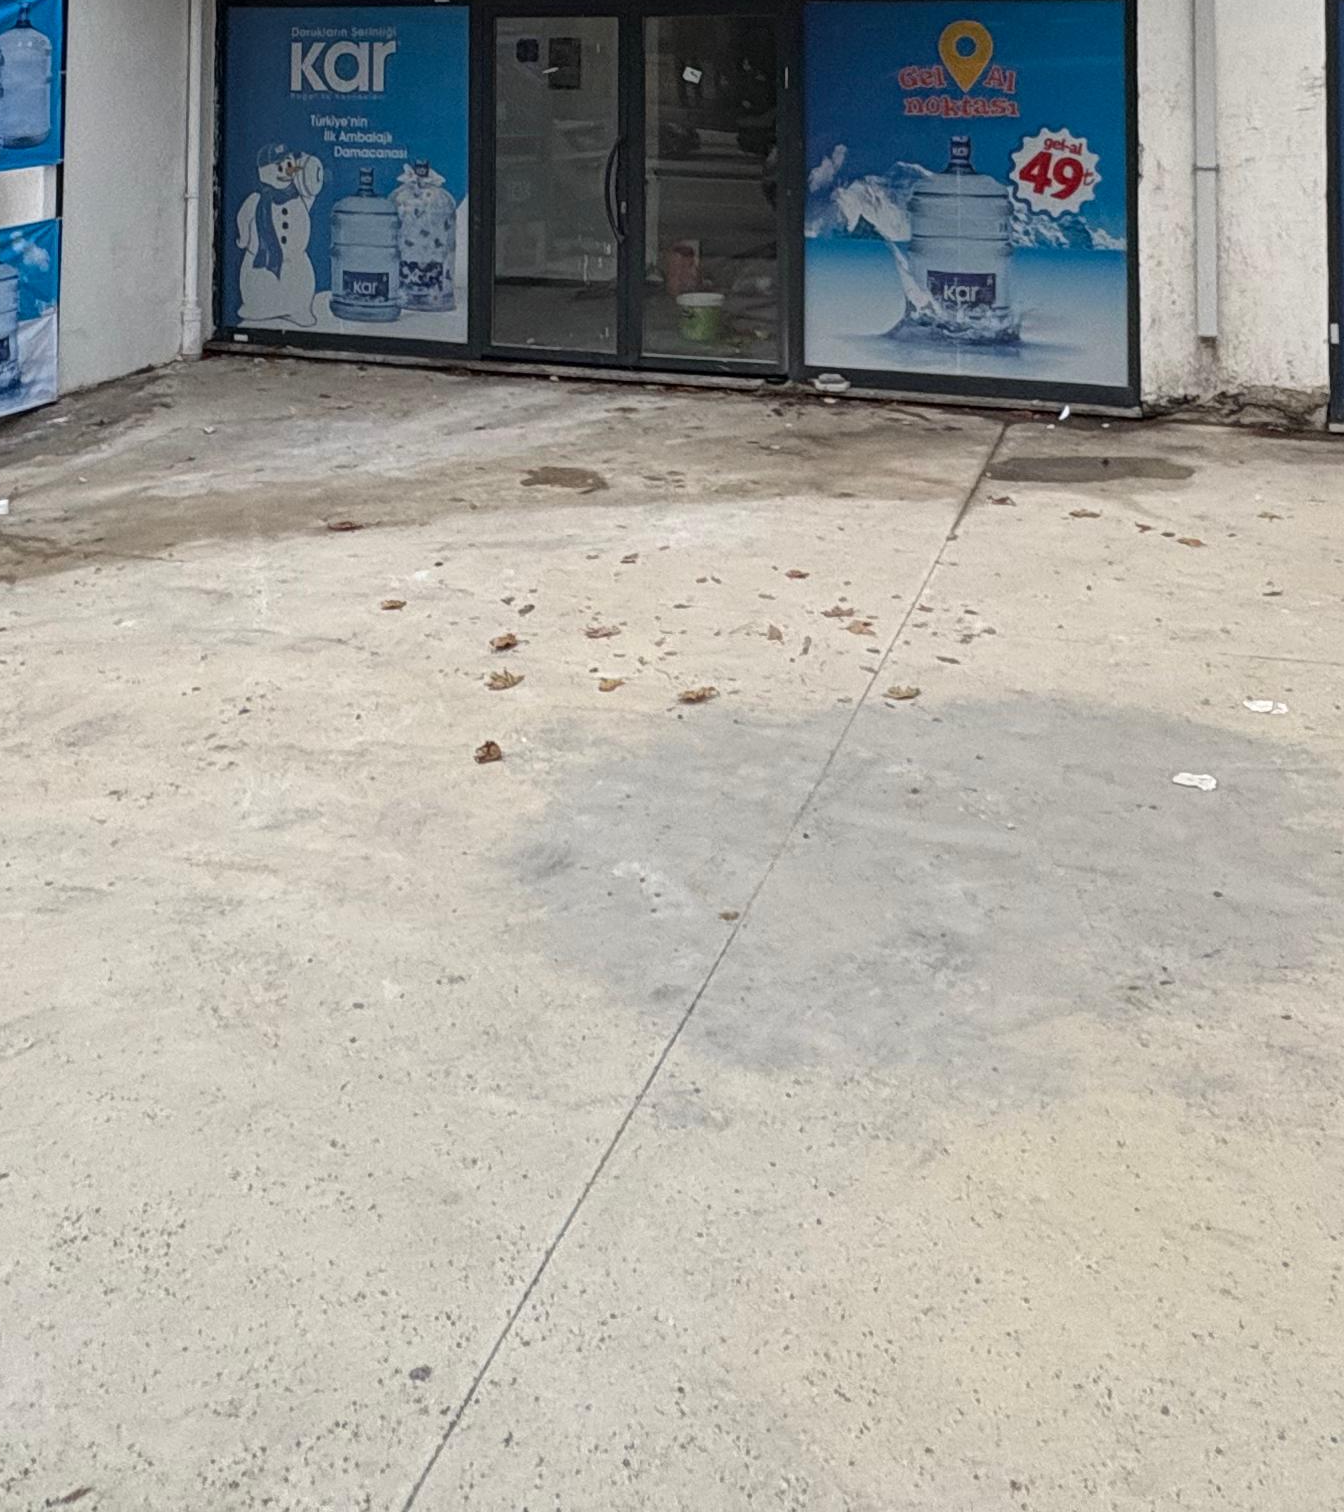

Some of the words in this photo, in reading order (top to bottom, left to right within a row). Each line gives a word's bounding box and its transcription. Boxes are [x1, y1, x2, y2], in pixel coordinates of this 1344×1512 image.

[290, 40, 397, 93] kar
[898, 65, 947, 90] Gel
[903, 94, 1020, 118] noktası
